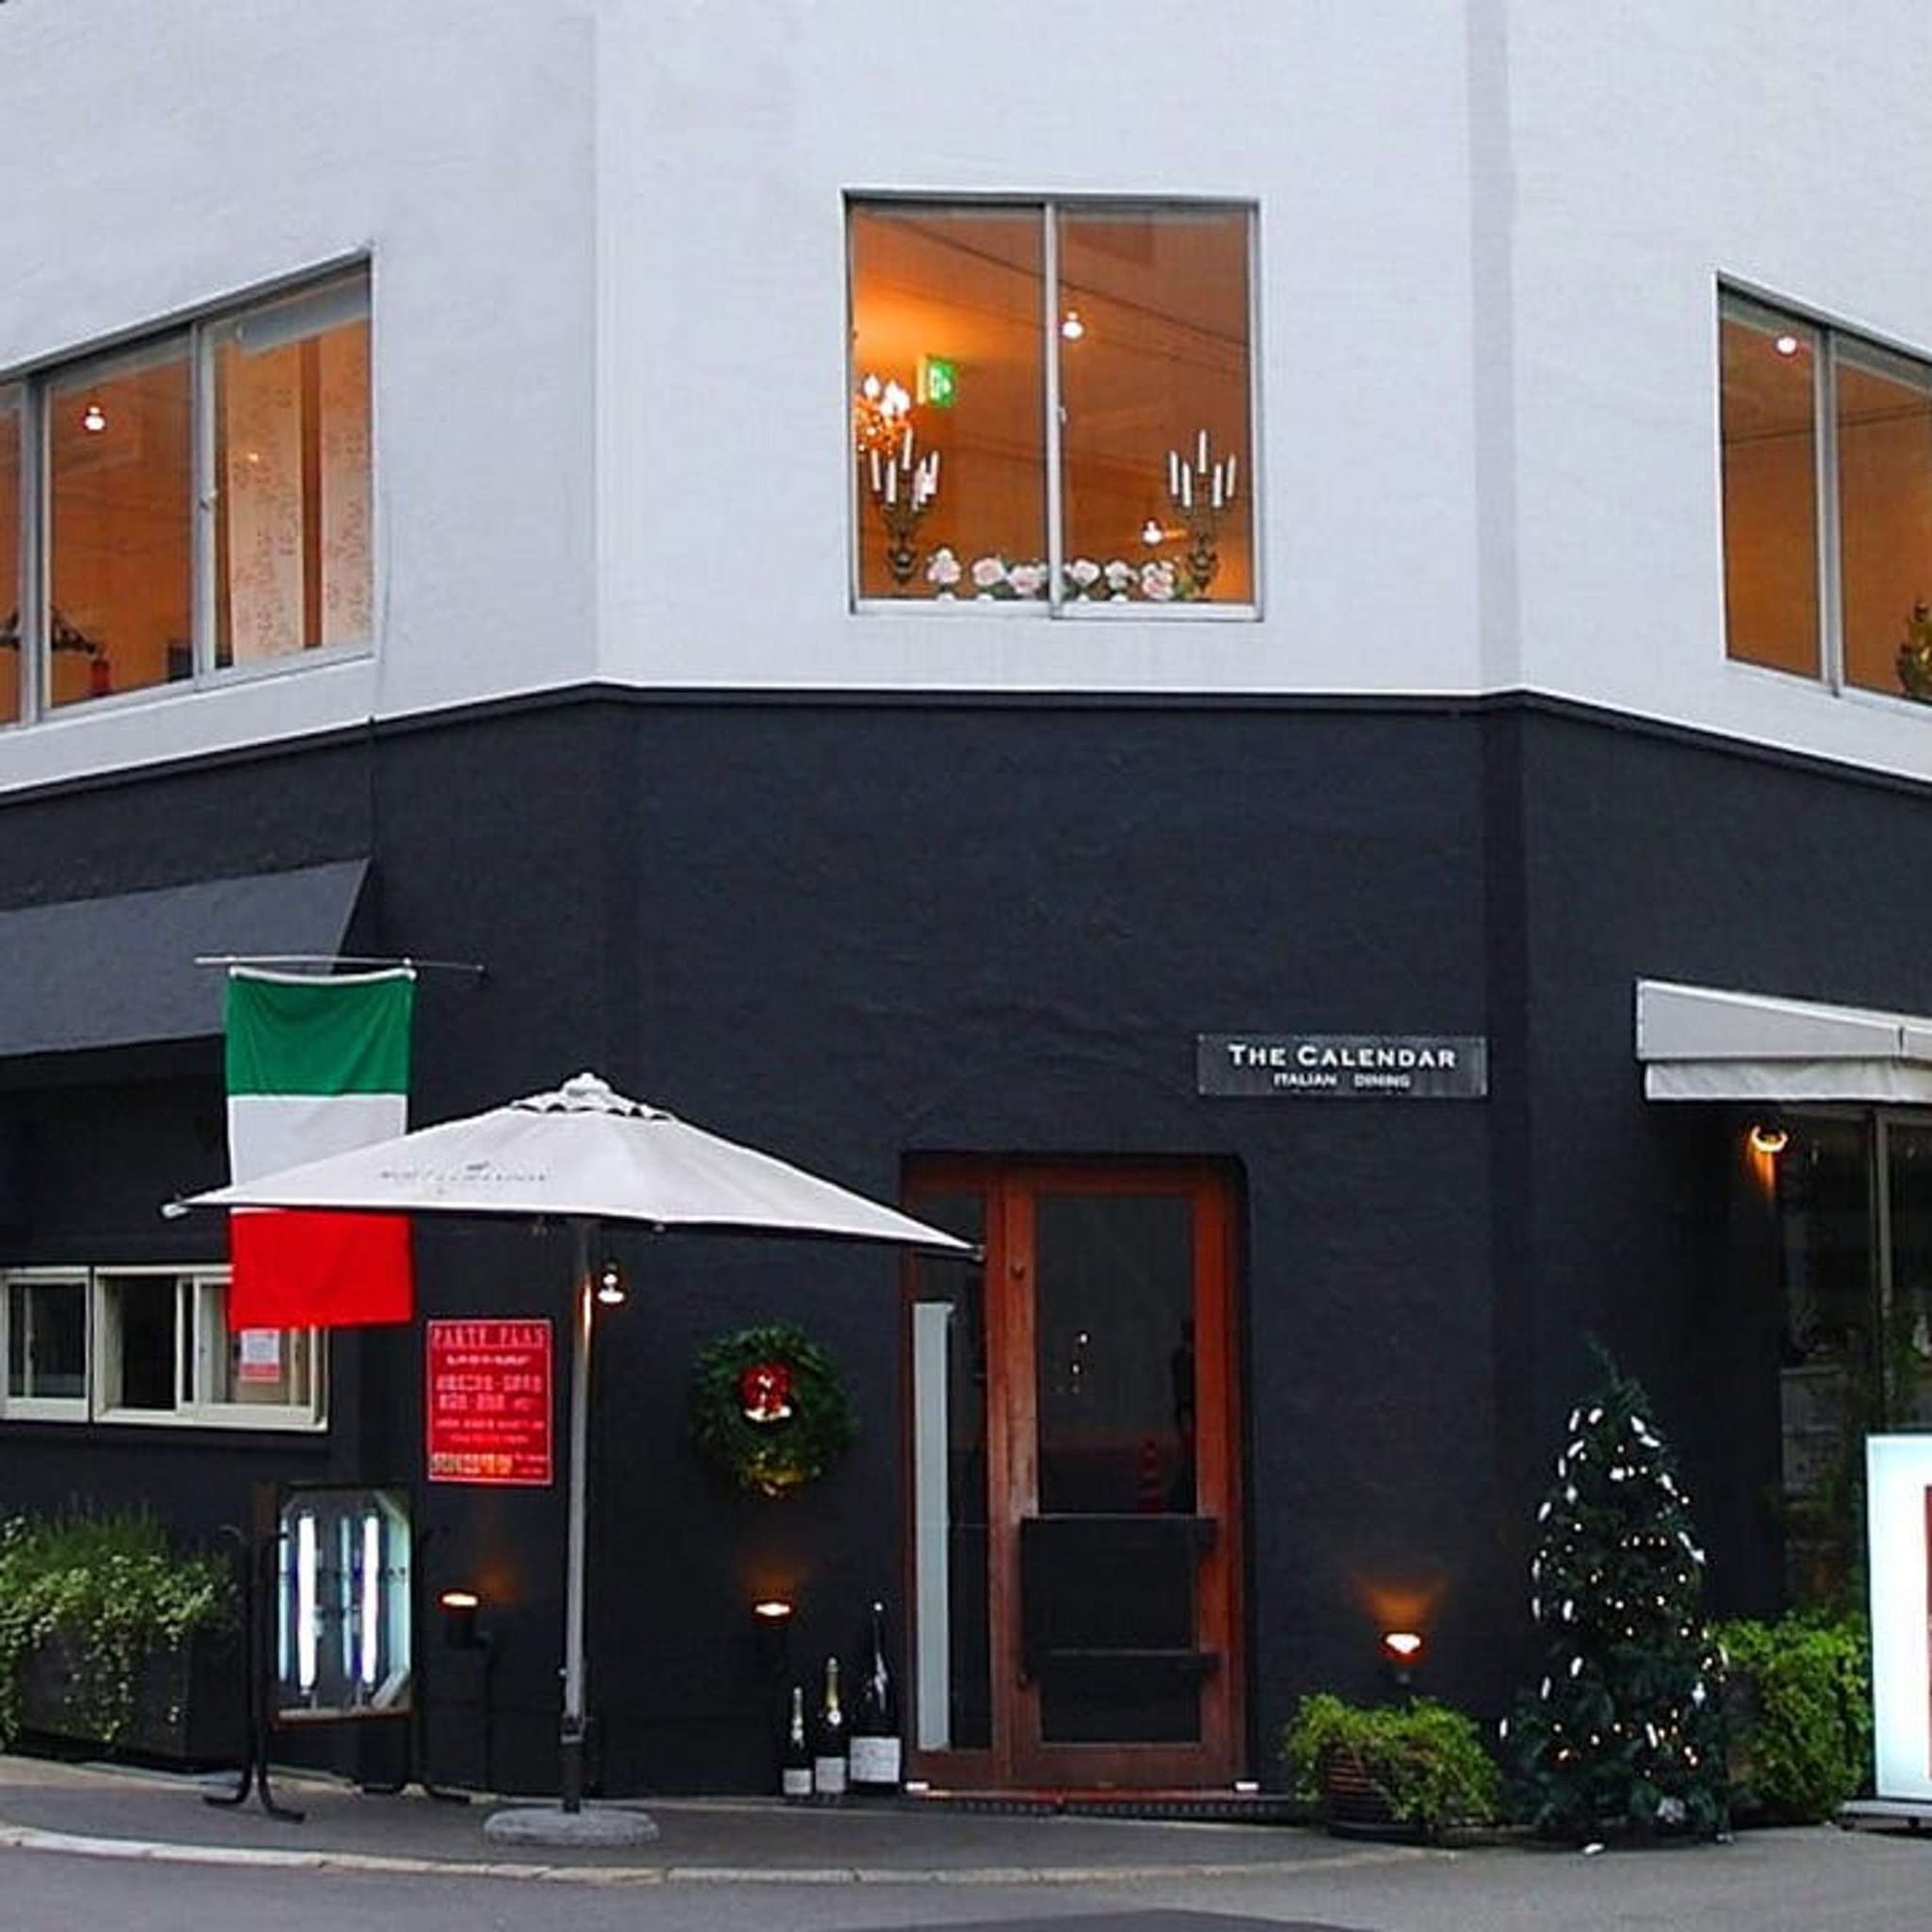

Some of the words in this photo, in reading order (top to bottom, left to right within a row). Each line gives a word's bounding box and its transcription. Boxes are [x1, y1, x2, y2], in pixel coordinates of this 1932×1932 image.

[1228, 1044, 1287, 1066] THE
[1297, 1045, 1456, 1068] CALENDAR
[1274, 1072, 1337, 1087] ITALIAN
[1354, 1072, 1410, 1089] DINING
